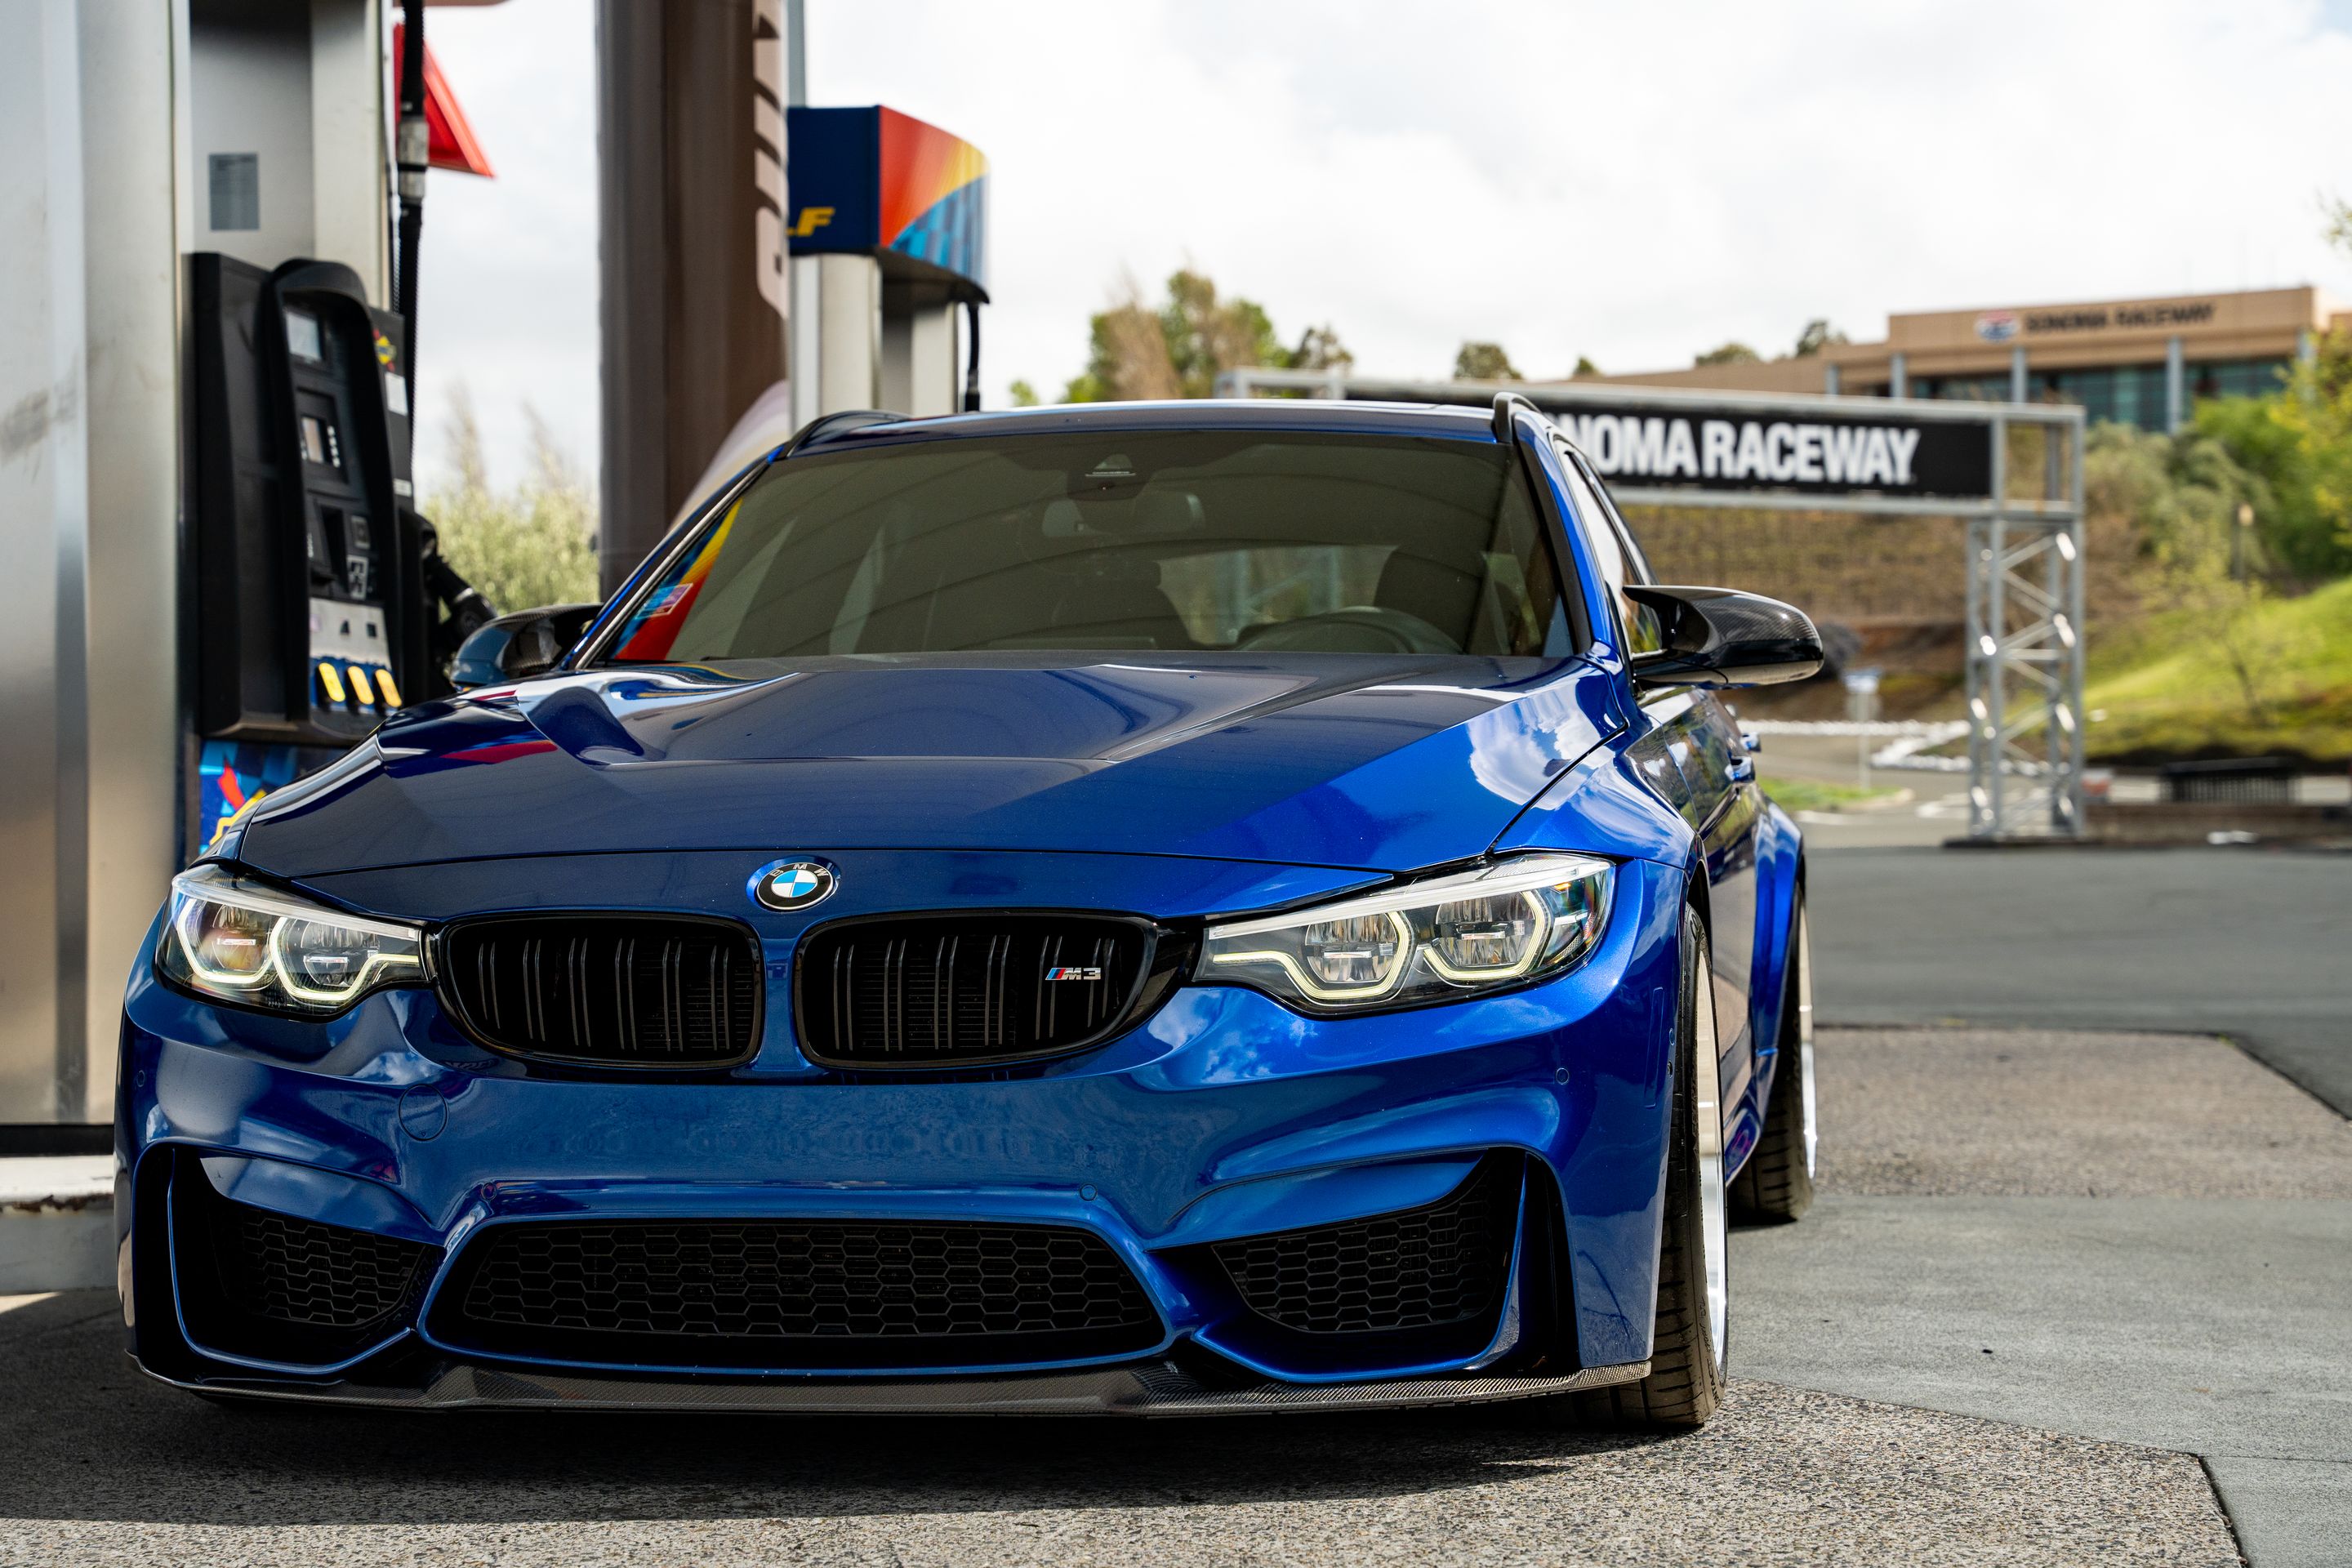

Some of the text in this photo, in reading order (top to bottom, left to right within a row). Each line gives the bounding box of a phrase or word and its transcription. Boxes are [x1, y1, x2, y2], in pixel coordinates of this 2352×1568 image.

[786, 207, 835, 237] F
[1544, 412, 1921, 485] NOMA RACEWAY
[768, 862, 830, 878] BMW
[1060, 967, 1102, 980] M3
